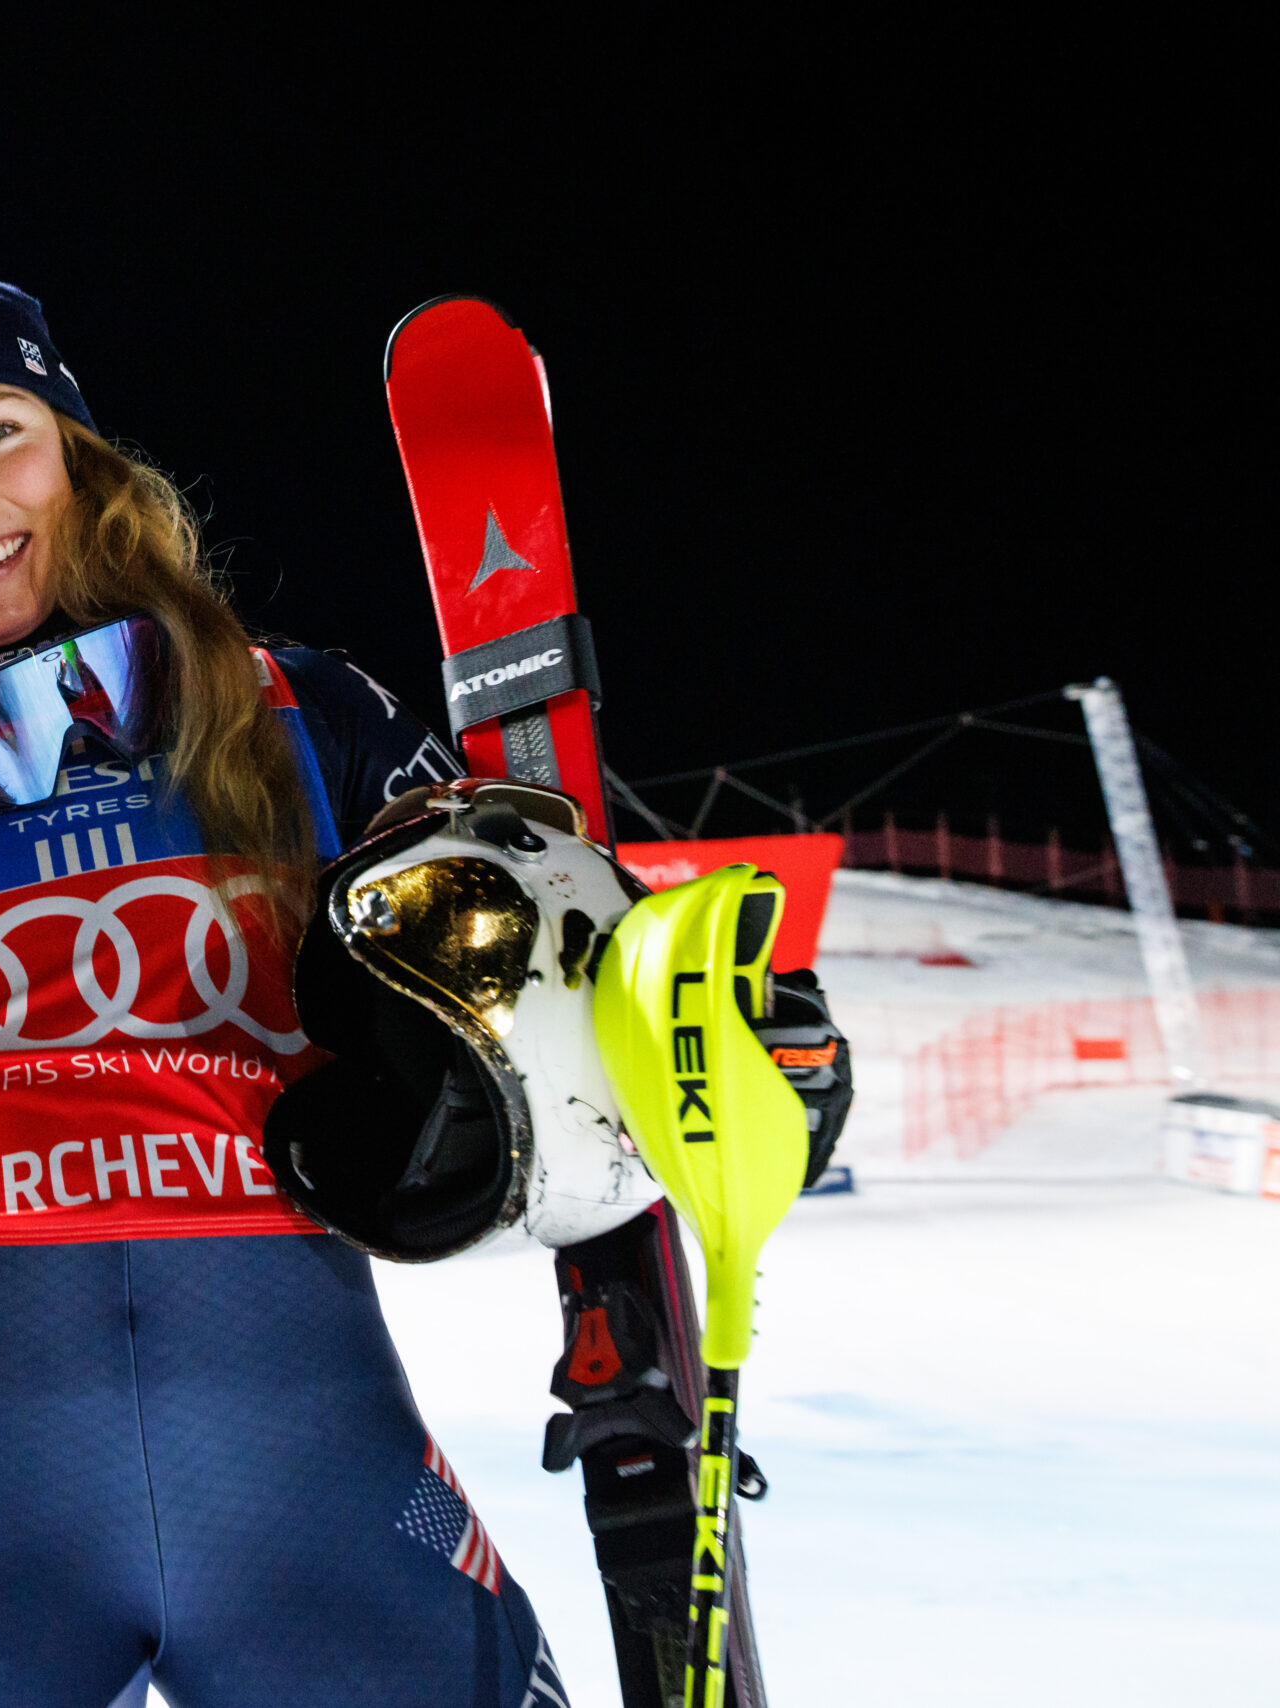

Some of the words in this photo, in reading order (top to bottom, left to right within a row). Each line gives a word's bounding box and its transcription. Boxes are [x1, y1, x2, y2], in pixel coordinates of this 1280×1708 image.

[19, 339, 41, 356] US
[450, 648, 564, 702] ATOMIC
[8, 793, 152, 833] TYRES
[3, 1060, 58, 1090] FIS
[70, 1049, 131, 1079] Ski
[140, 1047, 262, 1080] World
[673, 972, 714, 1142] LEKI
[692, 1397, 734, 1592] LEKI
